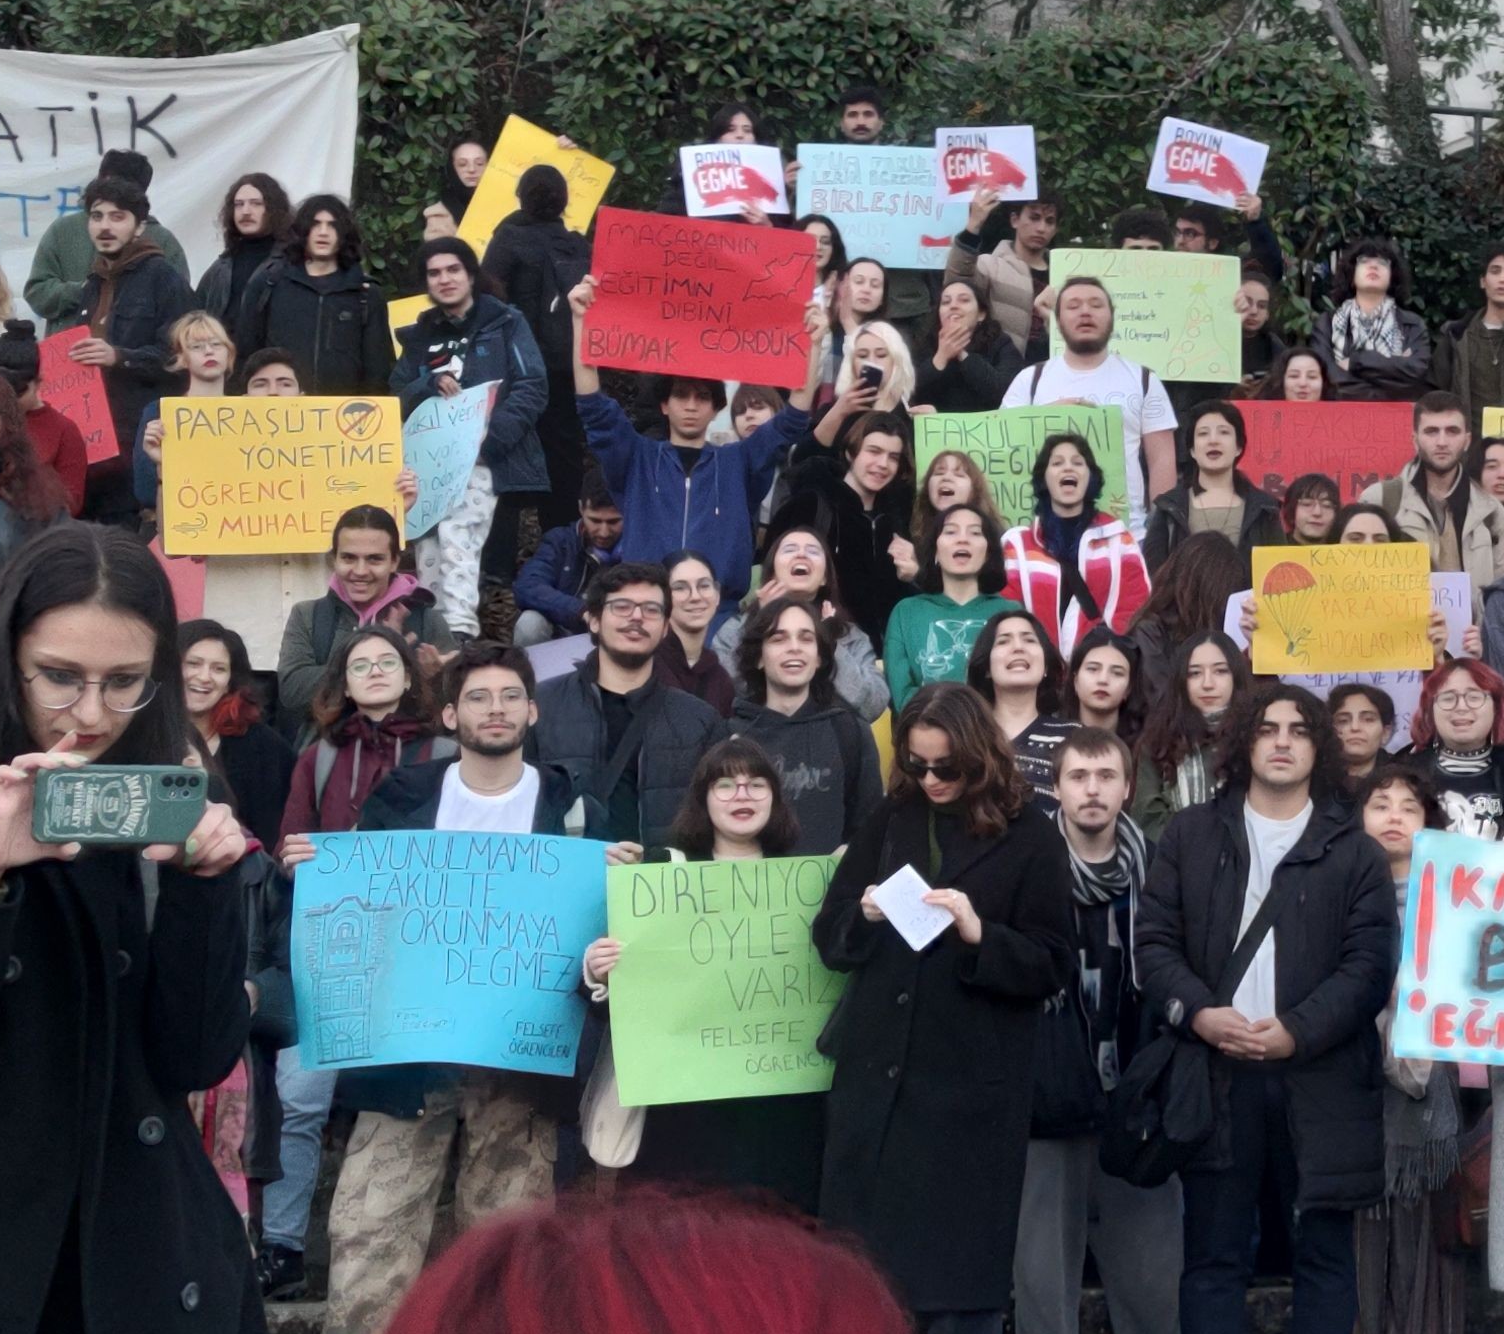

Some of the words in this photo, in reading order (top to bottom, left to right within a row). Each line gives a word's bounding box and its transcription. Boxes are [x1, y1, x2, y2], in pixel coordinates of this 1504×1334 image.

[588, 324, 679, 364] BÜMAK
[700, 325, 808, 359] GÖRDÜK
[175, 403, 332, 441] PARAŞÜT
[240, 440, 395, 471] YÖNETİME
[177, 473, 306, 509] ÖĞRENCİ
[1310, 548, 1420, 568] KAYYUMU
[318, 835, 561, 879] SAVUNULMAMIŞ
[367, 870, 504, 911] FAKÜLTE
[400, 908, 561, 952] OKUNMAYA
[700, 1019, 805, 1048] FELSEFE
